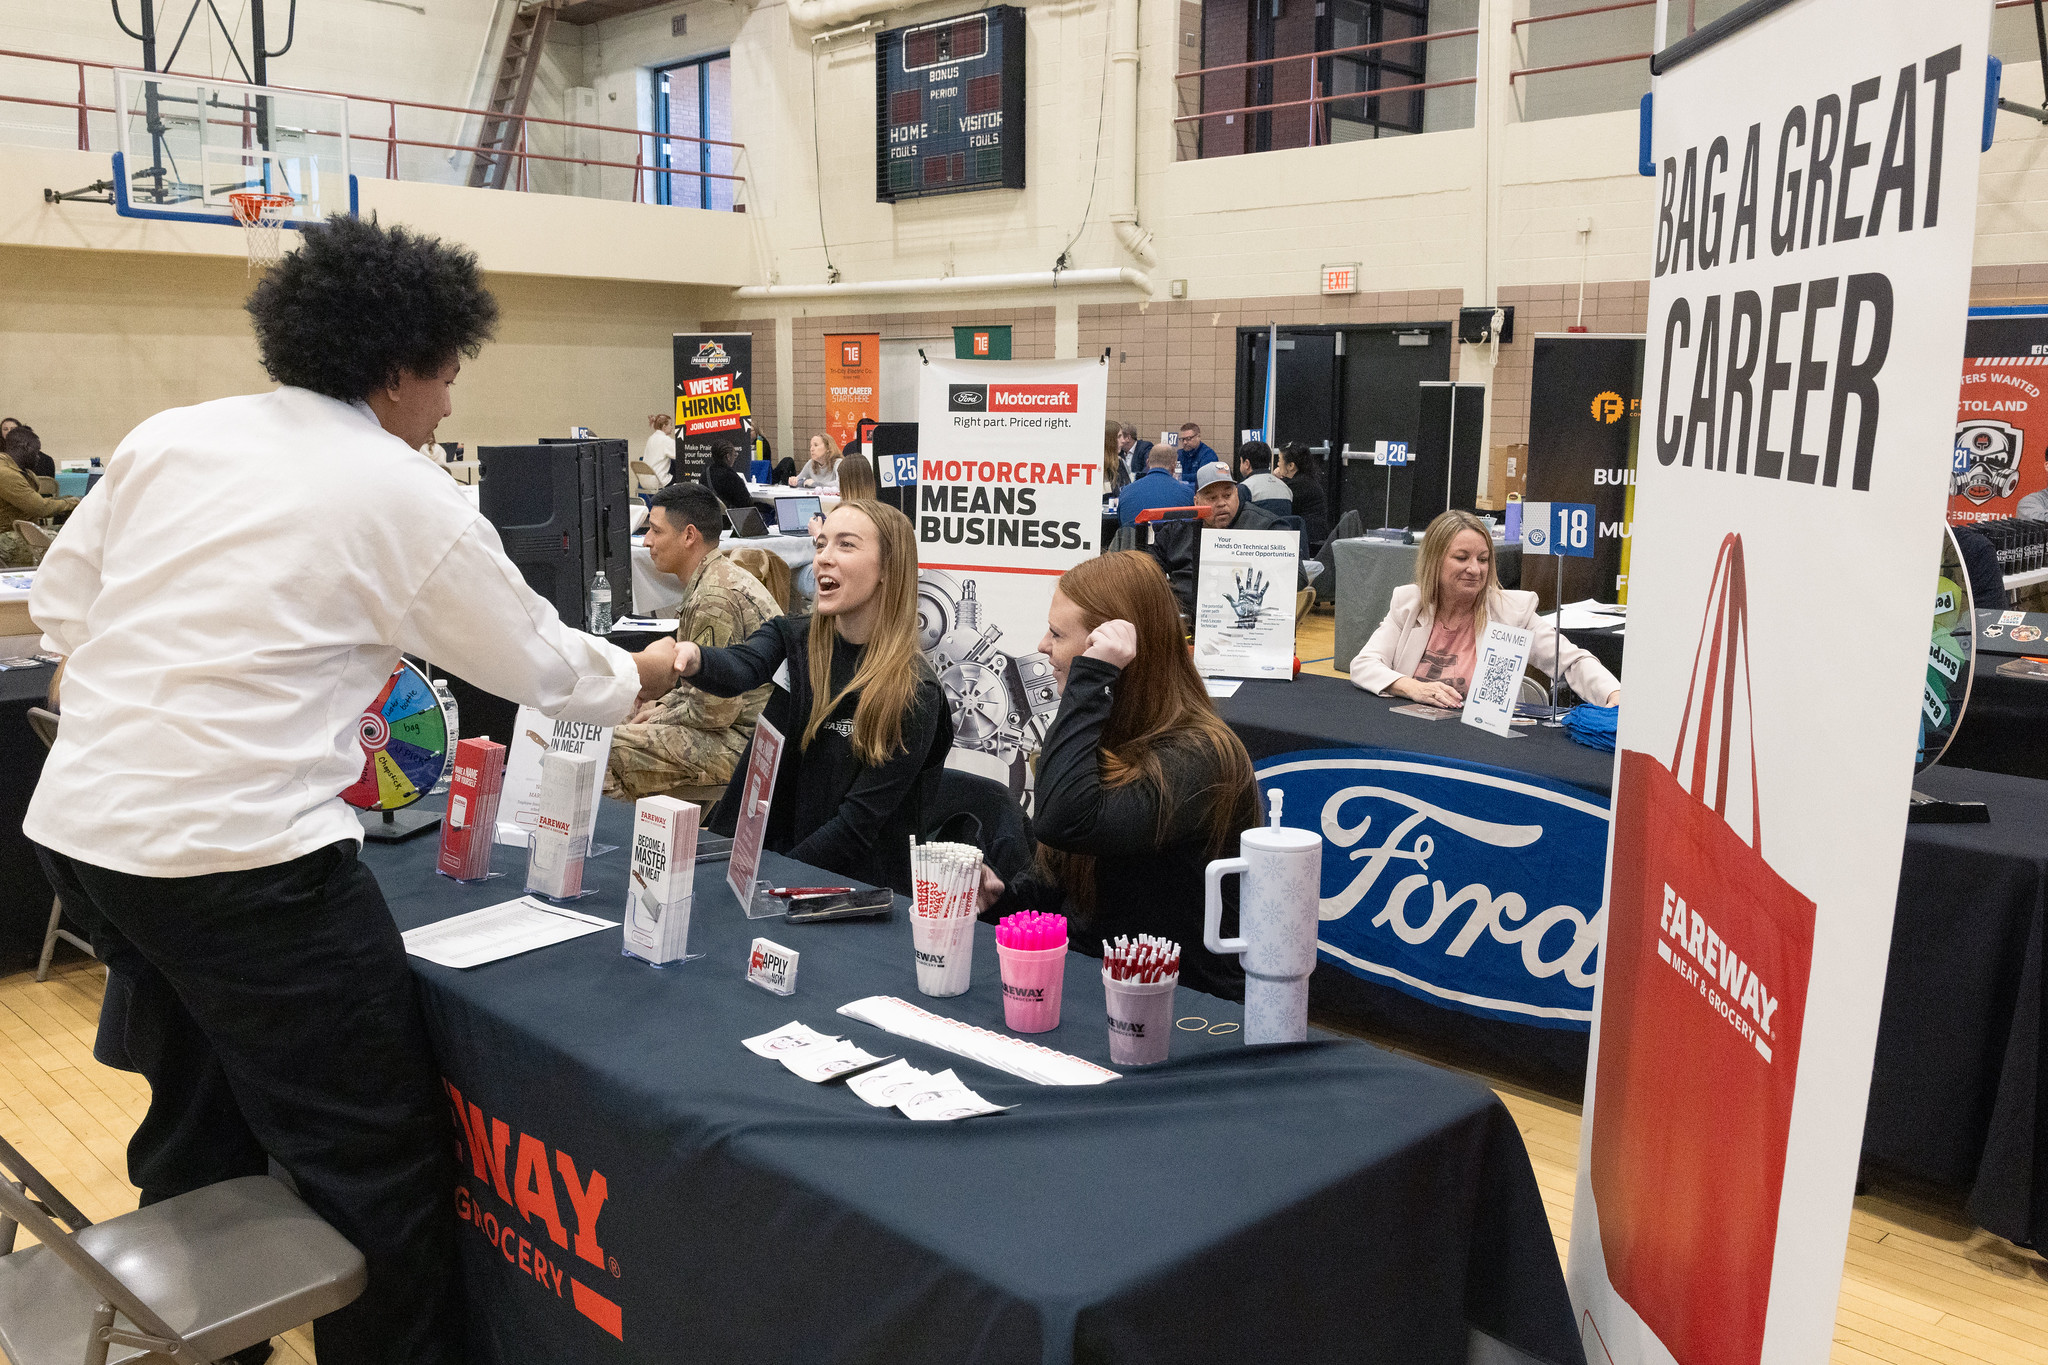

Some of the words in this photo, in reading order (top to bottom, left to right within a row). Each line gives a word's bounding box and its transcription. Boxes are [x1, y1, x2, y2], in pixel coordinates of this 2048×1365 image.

[929, 67, 959, 82] BONUS
[930, 87, 958, 100] PERIOD
[890, 124, 928, 142] HOME
[970, 133, 998, 147] FOULS
[890, 146, 918, 158] FOULS
[1655, 135, 1729, 278] BAG
[1729, 122, 1761, 264] A
[1770, 44, 1962, 257] GREAT
[1328, 271, 1350, 290] EXIT
[1656, 272, 1894, 492] CAREER
[1990, 373, 2040, 398] WANTED
[682, 394, 741, 418] HIRING!
[1630, 399, 1642, 410] F
[1958, 400, 2028, 412] TOLAND
[690, 421, 704, 431] JOIN
[704, 420, 718, 428] OUR
[718, 418, 736, 427] TEAM
[954, 416, 980, 428] Right
[983, 418, 1007, 428] part.
[1009, 417, 1042, 427] Priced
[1044, 417, 1071, 429] right.
[1168, 434, 1178, 446] 37
[1252, 430, 1261, 442] 31
[1388, 444, 1406, 462] 26
[1954, 449, 1967, 469] 21
[896, 457, 916, 480] 25
[922, 460, 1097, 485] MOTORCRAFT
[922, 485, 1037, 515] MEANS
[920, 516, 1091, 550] BUSINESS.
[1558, 509, 1588, 548] 18
[1616, 575, 1629, 590] F
[1490, 629, 1513, 644] SCAN
[1512, 634, 1527, 647] ME!
[404, 724, 420, 734] bag
[552, 720, 602, 742] MASTER
[551, 738, 560, 750] IN
[561, 740, 585, 754] MEAT
[540, 816, 570, 831] FAREWAY
[641, 811, 667, 825] FAREWAY
[638, 834, 660, 850] BECOME
[661, 842, 665, 853] A
[634, 845, 666, 872] MASTER
[639, 864, 644, 877] IN
[645, 866, 660, 882] MEAT
[763, 953, 788, 975] APPLY
[1660, 882, 1778, 1036] FAREWAY
[1672, 953, 1699, 987] MEAT
[1700, 980, 1706, 997] &
[1708, 989, 1755, 1042] GROCERY
[443, 1078, 608, 1270] WAY
[454, 1186, 563, 1298] GROCERY
